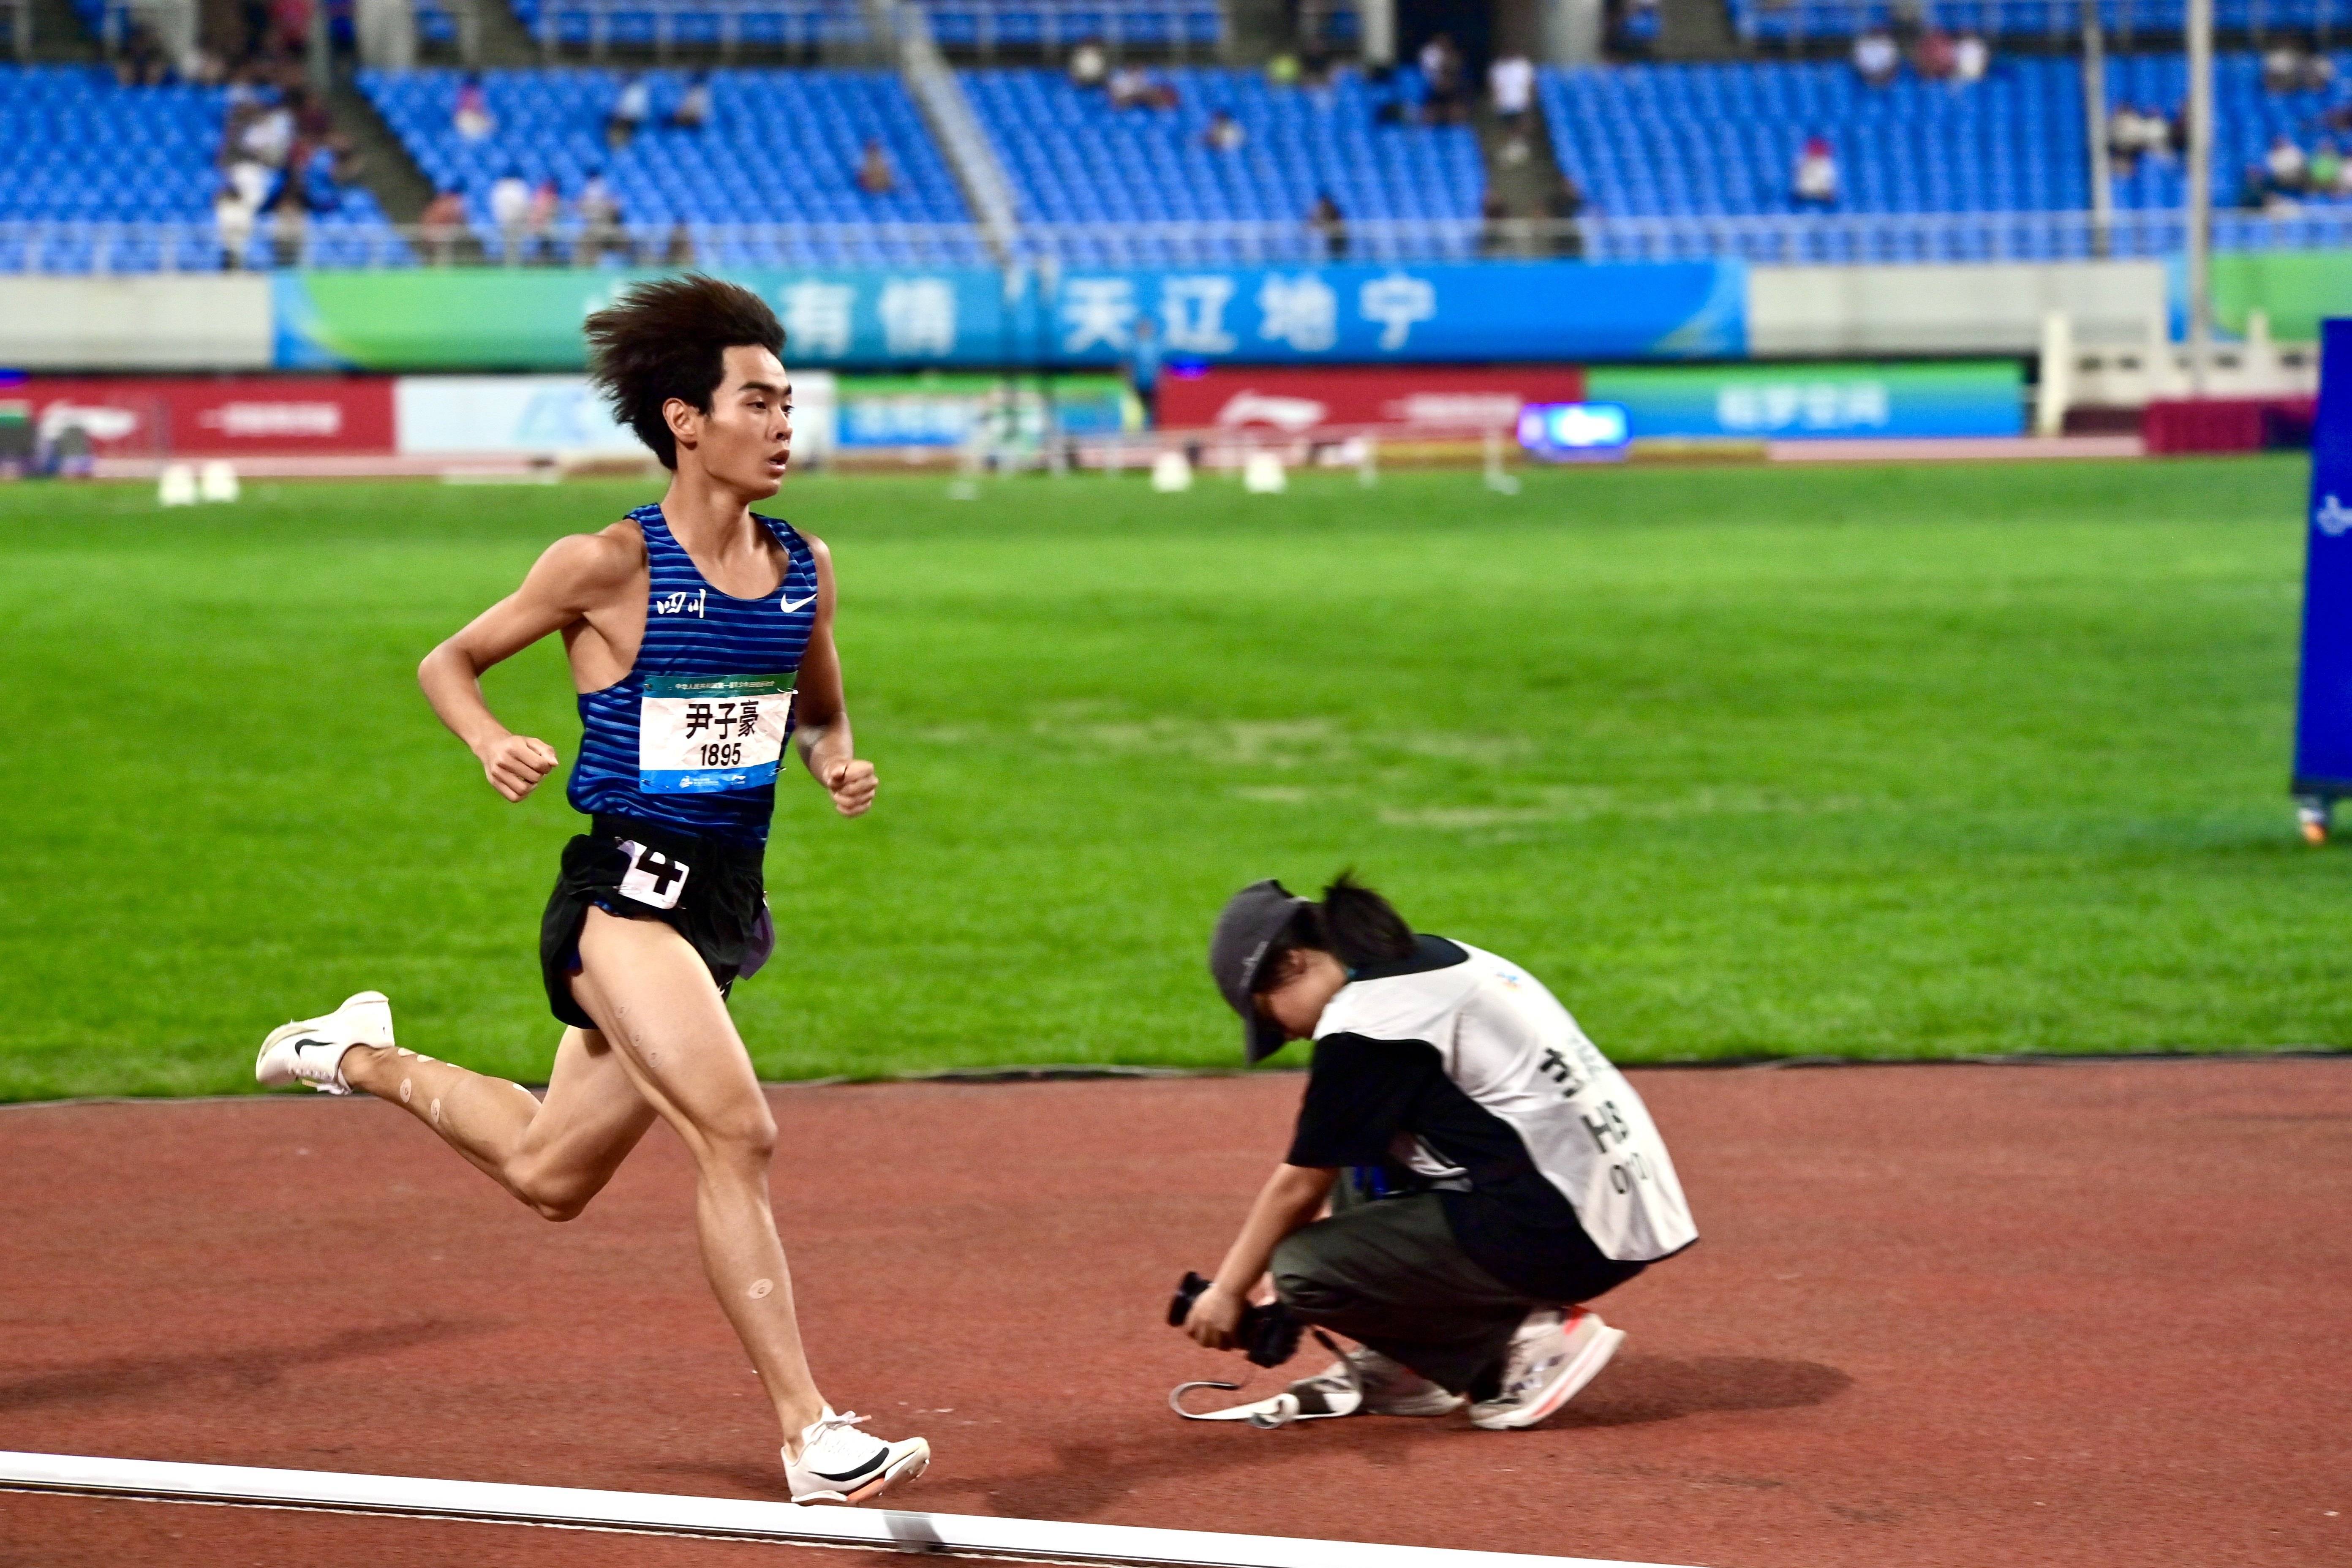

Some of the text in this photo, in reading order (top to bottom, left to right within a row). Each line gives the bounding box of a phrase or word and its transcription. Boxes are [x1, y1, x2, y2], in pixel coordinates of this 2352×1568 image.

[1059, 272, 1435, 354] 天辽地宁
[656, 588, 706, 618] 四川
[685, 700, 759, 740] 尹子豪
[700, 743, 742, 766] 1895
[635, 849, 683, 896] 4
